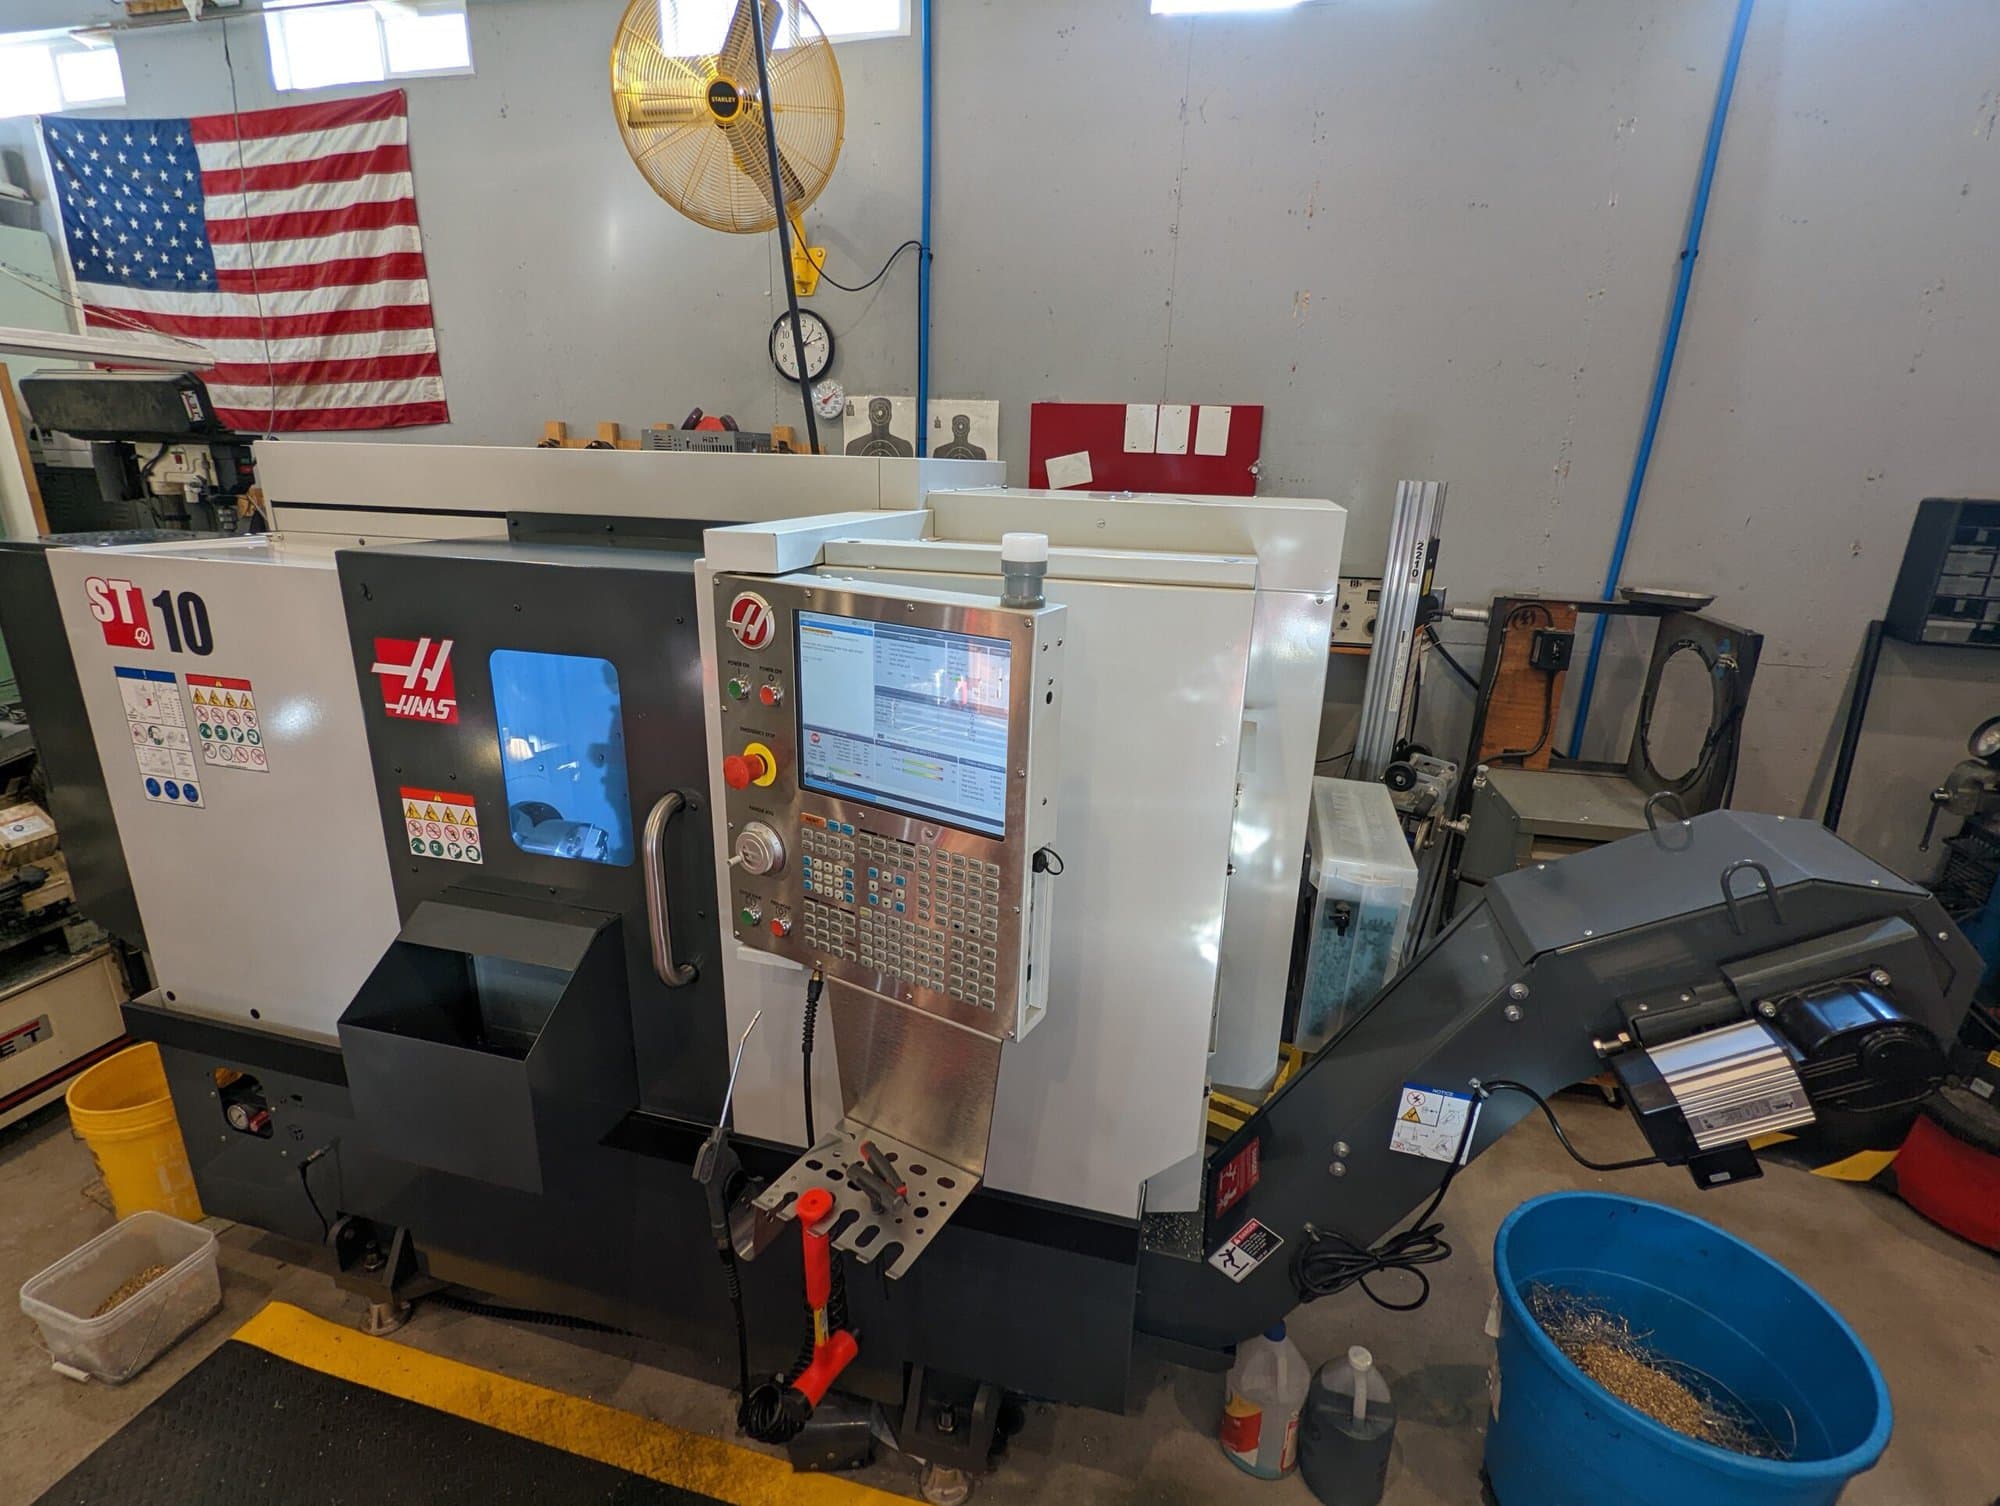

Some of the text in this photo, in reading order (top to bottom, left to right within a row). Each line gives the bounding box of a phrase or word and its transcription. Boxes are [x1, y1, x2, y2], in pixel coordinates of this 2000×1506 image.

[820, 344, 825, 352] 3
[1412, 542, 1424, 577] 2210
[85, 577, 213, 656] ST 10
[385, 695, 456, 719] HAAS
[1432, 1088, 1454, 1097] NOTICE
